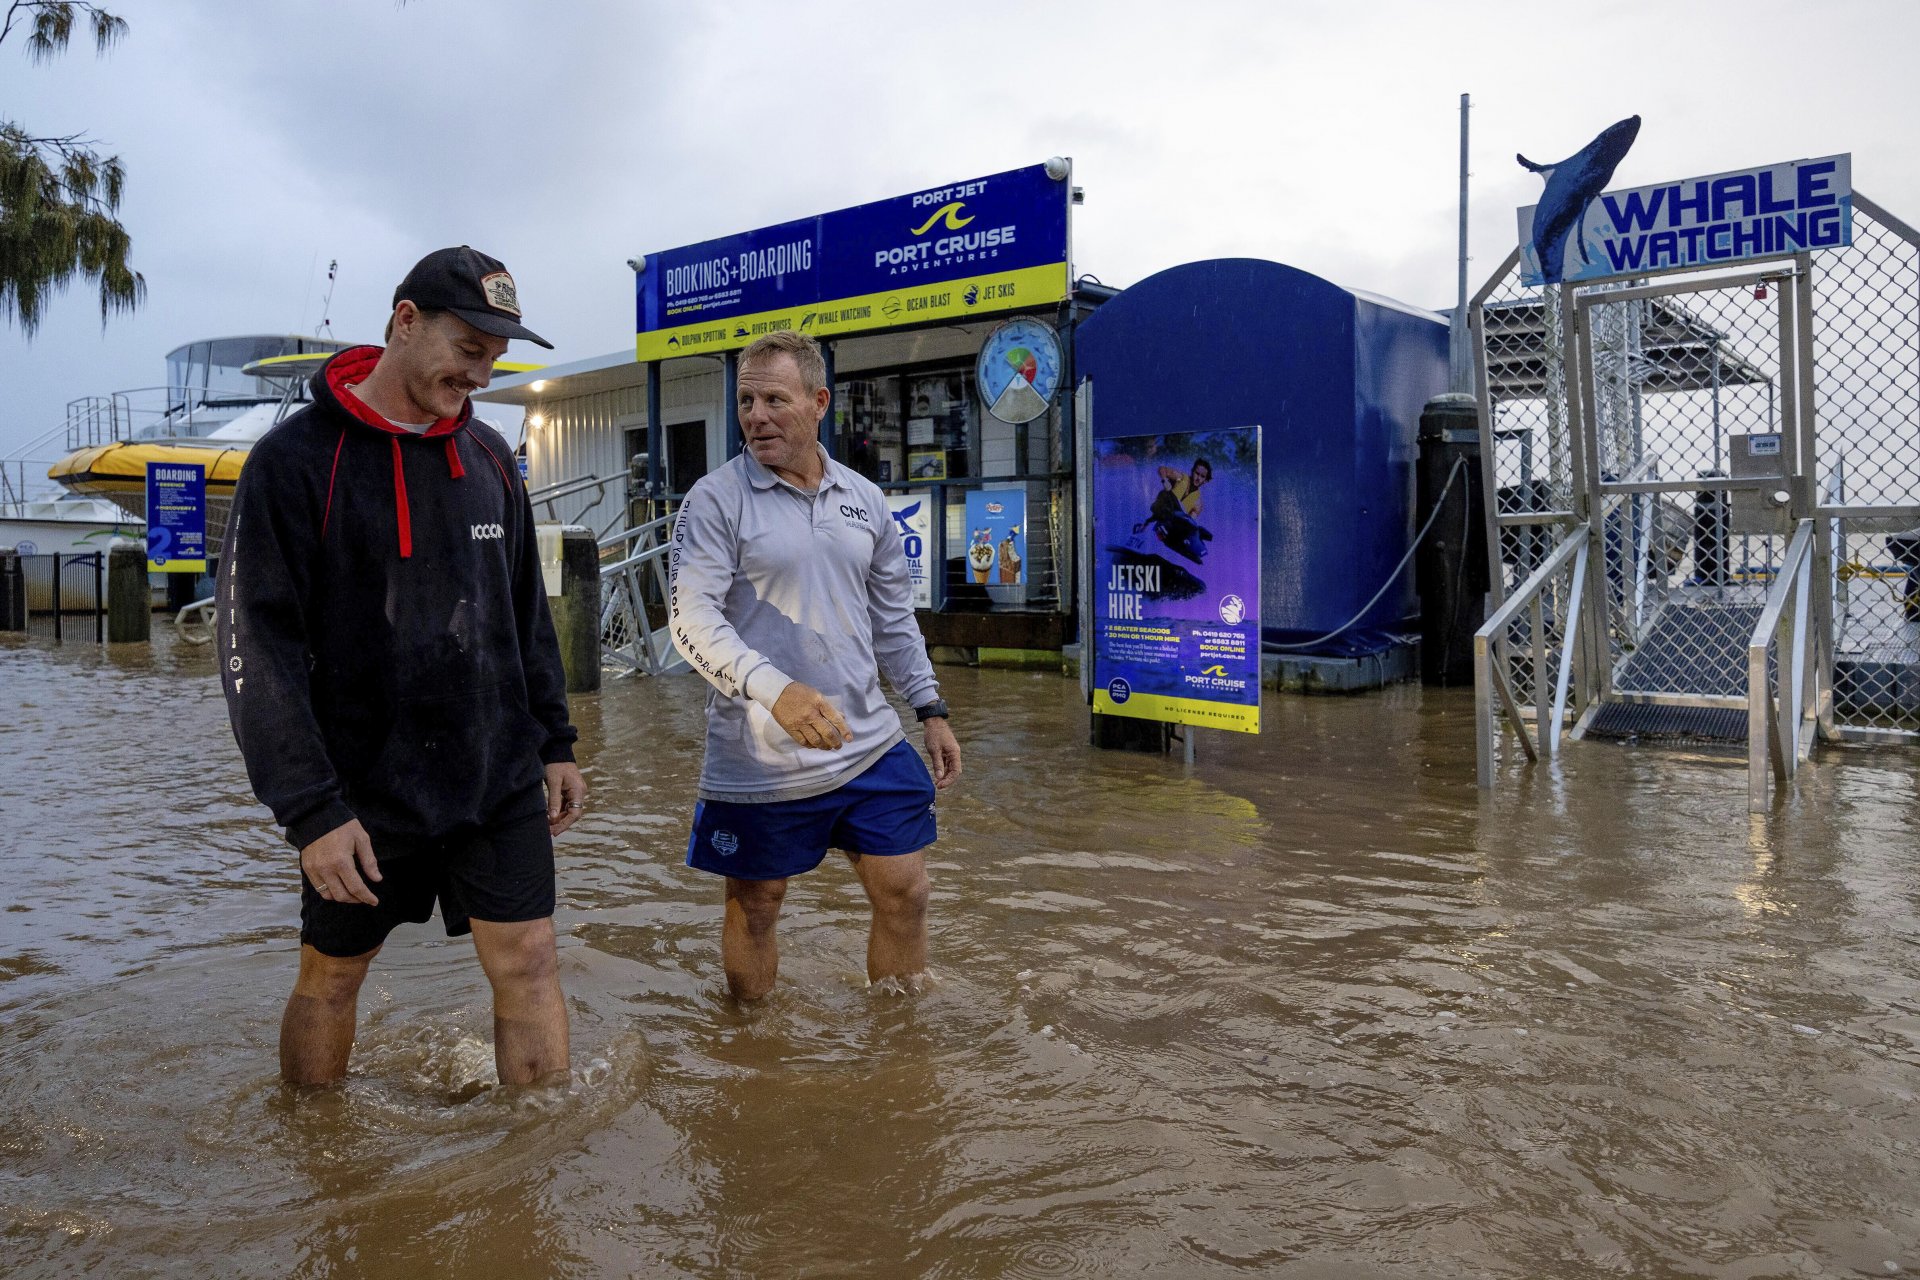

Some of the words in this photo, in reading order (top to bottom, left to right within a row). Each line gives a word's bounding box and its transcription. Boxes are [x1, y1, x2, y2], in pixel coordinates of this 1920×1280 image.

[913, 189, 954, 208] PORT
[955, 181, 987, 199] JET
[1601, 161, 1836, 234] WHALE
[875, 242, 931, 267] PORT
[935, 226, 1016, 256] CRUISE
[1604, 208, 1840, 270] WATCHING
[890, 250, 998, 275] ADVENTURES
[983, 285, 995, 300] JET
[998, 283, 1015, 297] SKIS
[683, 304, 702, 312] ONLINE
[907, 298, 928, 311] OCEAN
[930, 293, 950, 306] BLAST
[819, 312, 838, 324] WHALE
[840, 306, 871, 320] WATCHING
[752, 323, 768, 334] RIVER
[769, 319, 791, 332] CRUISES
[682, 334, 701, 346] DOLPHIN
[703, 329, 726, 342] SPOTTING
[156, 469, 196, 482] BOARDING
[840, 505, 868, 522] CNC
[148, 526, 172, 560] 2
[671, 548, 682, 582] YOUR
[907, 559, 923, 568] TAL
[1108, 564, 1160, 592] JETSKI
[670, 586, 680, 619] BOA
[1109, 593, 1143, 620] HIRE
[677, 627, 695, 654] LIFE
[1200, 652, 1245, 660] portjet.com.au
[694, 653, 735, 686] BALAN
[1186, 675, 1210, 685] PORT
[1212, 678, 1245, 688] CRUISE
[1192, 684, 1238, 692] ADVENTURES
[1176, 708, 1205, 716] LICENSE
[1208, 712, 1245, 720] REQUIRED
